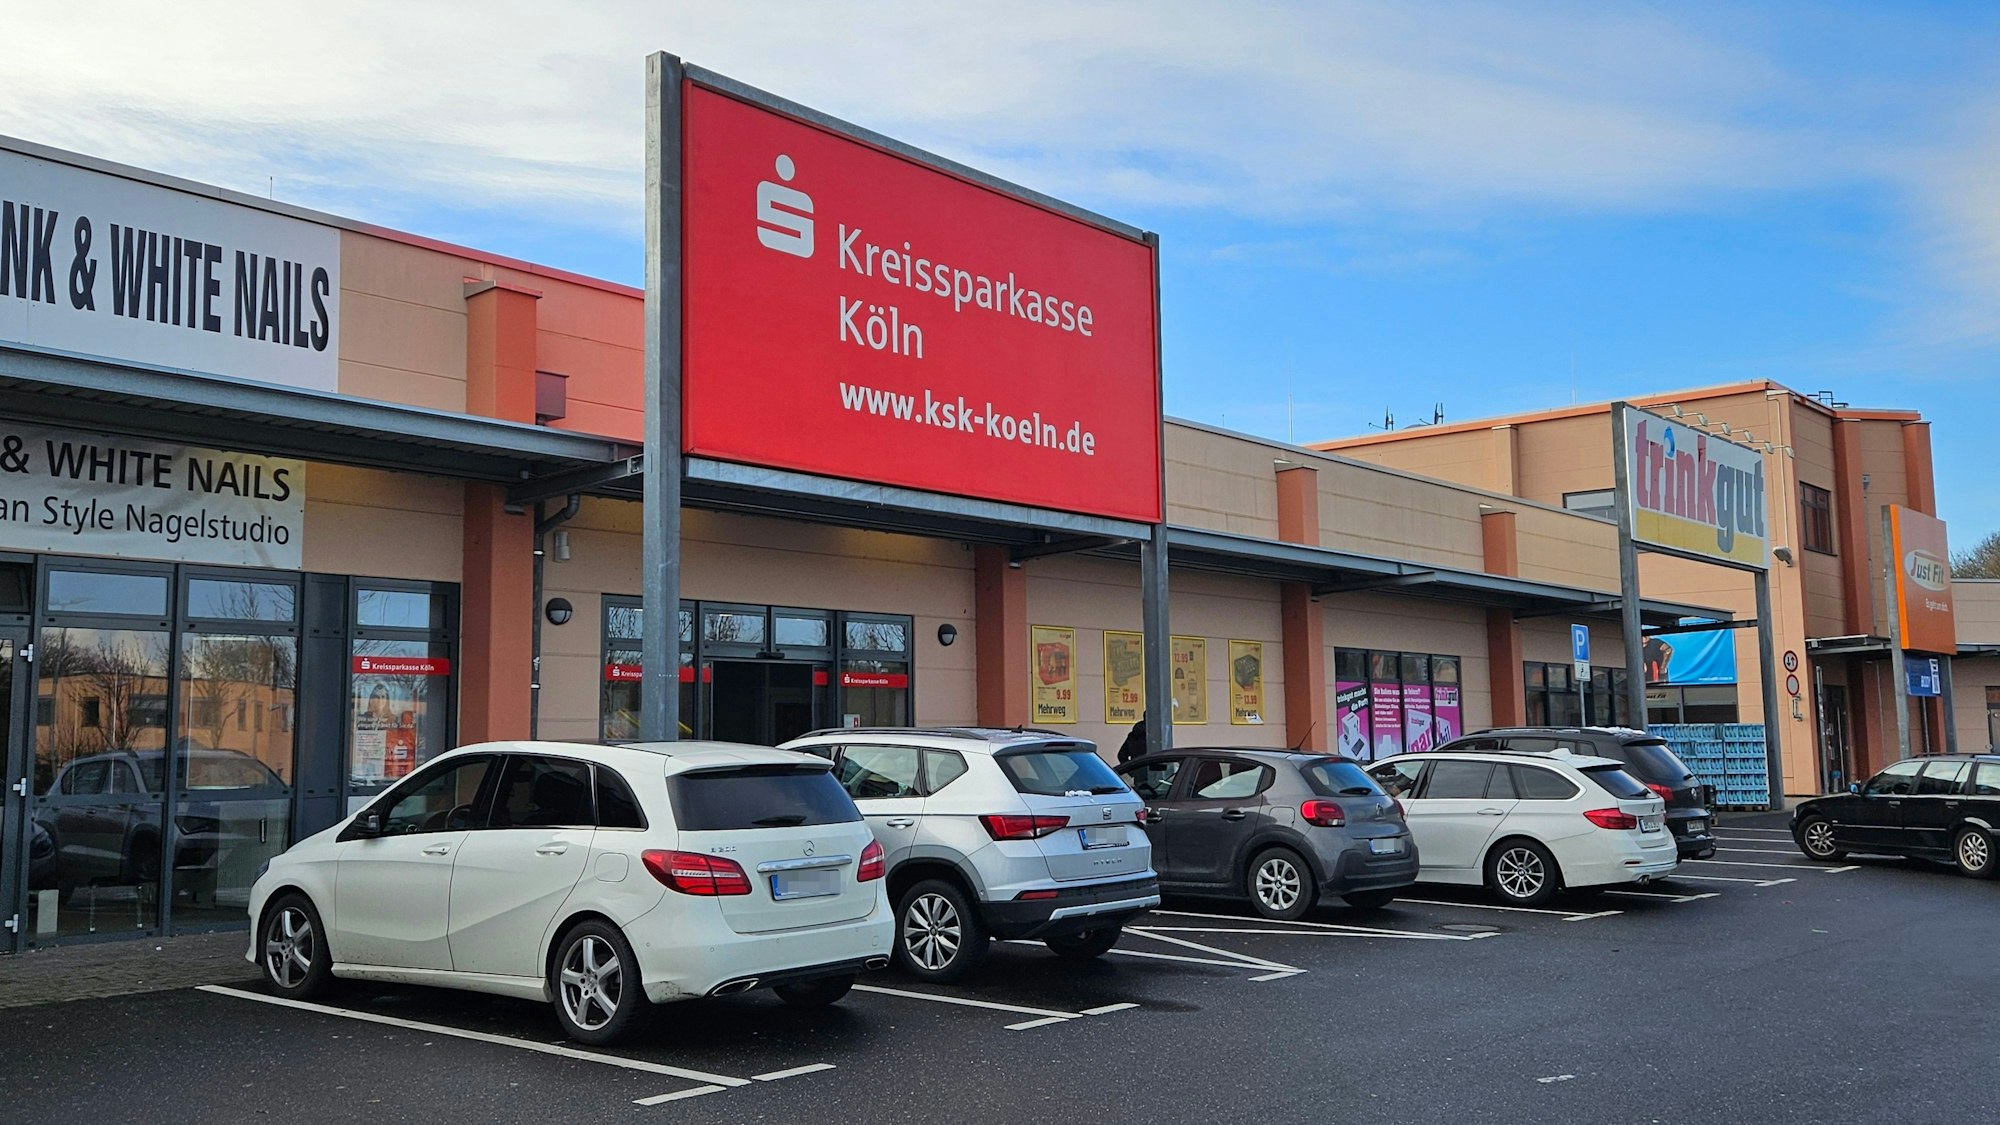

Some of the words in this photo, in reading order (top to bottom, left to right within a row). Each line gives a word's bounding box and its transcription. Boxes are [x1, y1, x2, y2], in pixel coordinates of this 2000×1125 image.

[0, 199, 59, 305] NK
[68, 215, 98, 312] &
[109, 222, 223, 334] WHITE
[233, 249, 331, 353] NAILS
[838, 223, 1094, 337] Kreissparkasse
[839, 295, 924, 359] Köln
[839, 382, 1096, 456] www.ksk-koeln.de
[0, 434, 30, 474] &
[46, 439, 174, 490] WHITE
[187, 457, 291, 502] NAILS
[1635, 419, 1765, 554] trinkgut
[42, 495, 115, 536] Style
[125, 503, 290, 545] Nagelstudio
[1932, 563, 1945, 585] Fit
[1575, 629, 1586, 656] P
[372, 662, 419, 672] Kreissparkasse
[420, 662, 435, 671] Köln
[1038, 704, 1066, 717] Mehrweg
[1056, 689, 1071, 701] 9.99
[1110, 707, 1135, 720] Mehrweg
[1122, 692, 1138, 704] 12.99
